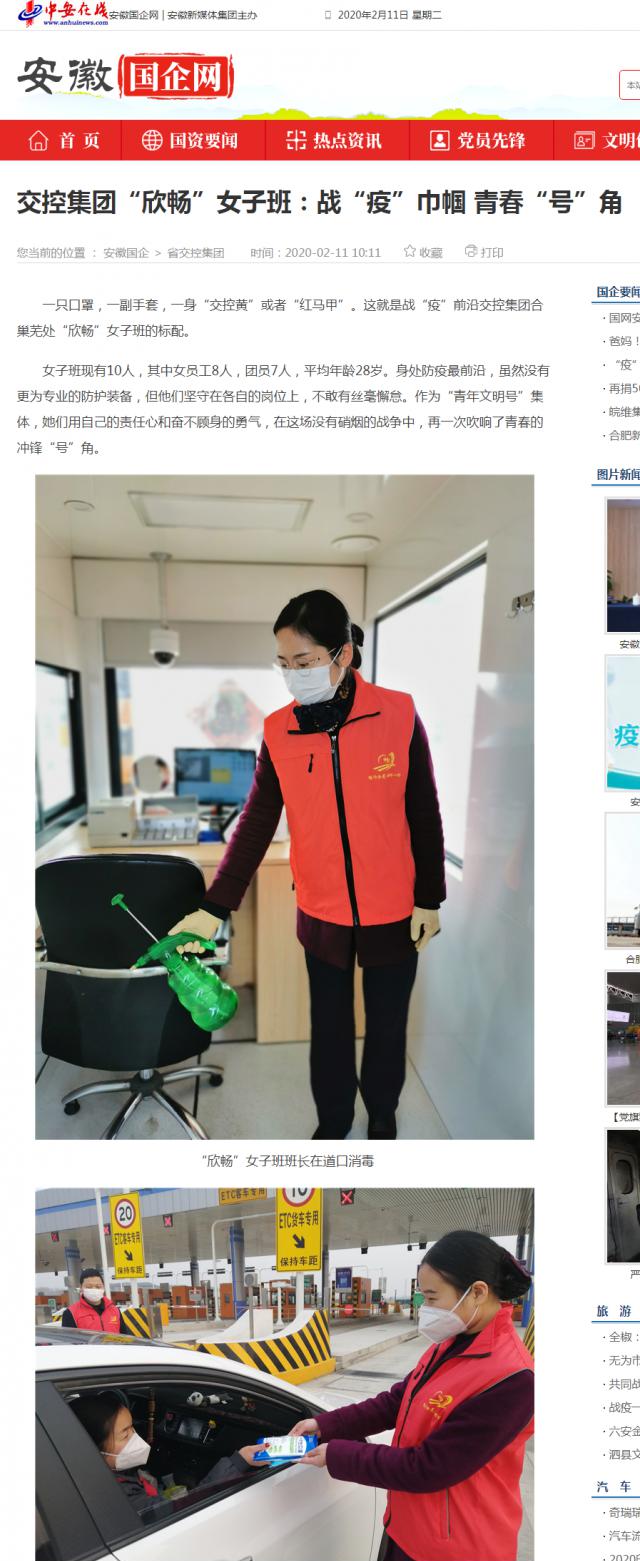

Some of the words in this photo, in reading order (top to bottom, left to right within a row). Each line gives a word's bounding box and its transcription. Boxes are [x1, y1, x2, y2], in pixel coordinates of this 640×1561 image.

[109, 10, 159, 20] 安徽国企网
[167, 10, 258, 20] 安徽新媒体集团主办
[338, 10, 408, 20] 2020年2月11日
[412, 10, 442, 20] 星期二
[17, 56, 114, 95] 安徽
[129, 61, 222, 93] 国企网
[169, 131, 238, 150] 国资要闻
[313, 131, 382, 150] 热点资讯
[457, 131, 526, 150] 党员先锋
[602, 131, 640, 150] 文明
[103, 247, 150, 259] 安徽国企
[167, 247, 225, 259] 省交控集团
[351, 247, 381, 258] 10:11
[419, 247, 443, 259] 收藏
[480, 247, 504, 259] 打印
[609, 382, 640, 395] 再捐5
[202, 1153, 375, 1168] “欣畅”女子班班长在道口消毒
[118, 1205, 133, 1221] 20
[279, 1210, 319, 1229] ETC货车专用
[280, 1255, 318, 1267] 保持车距
